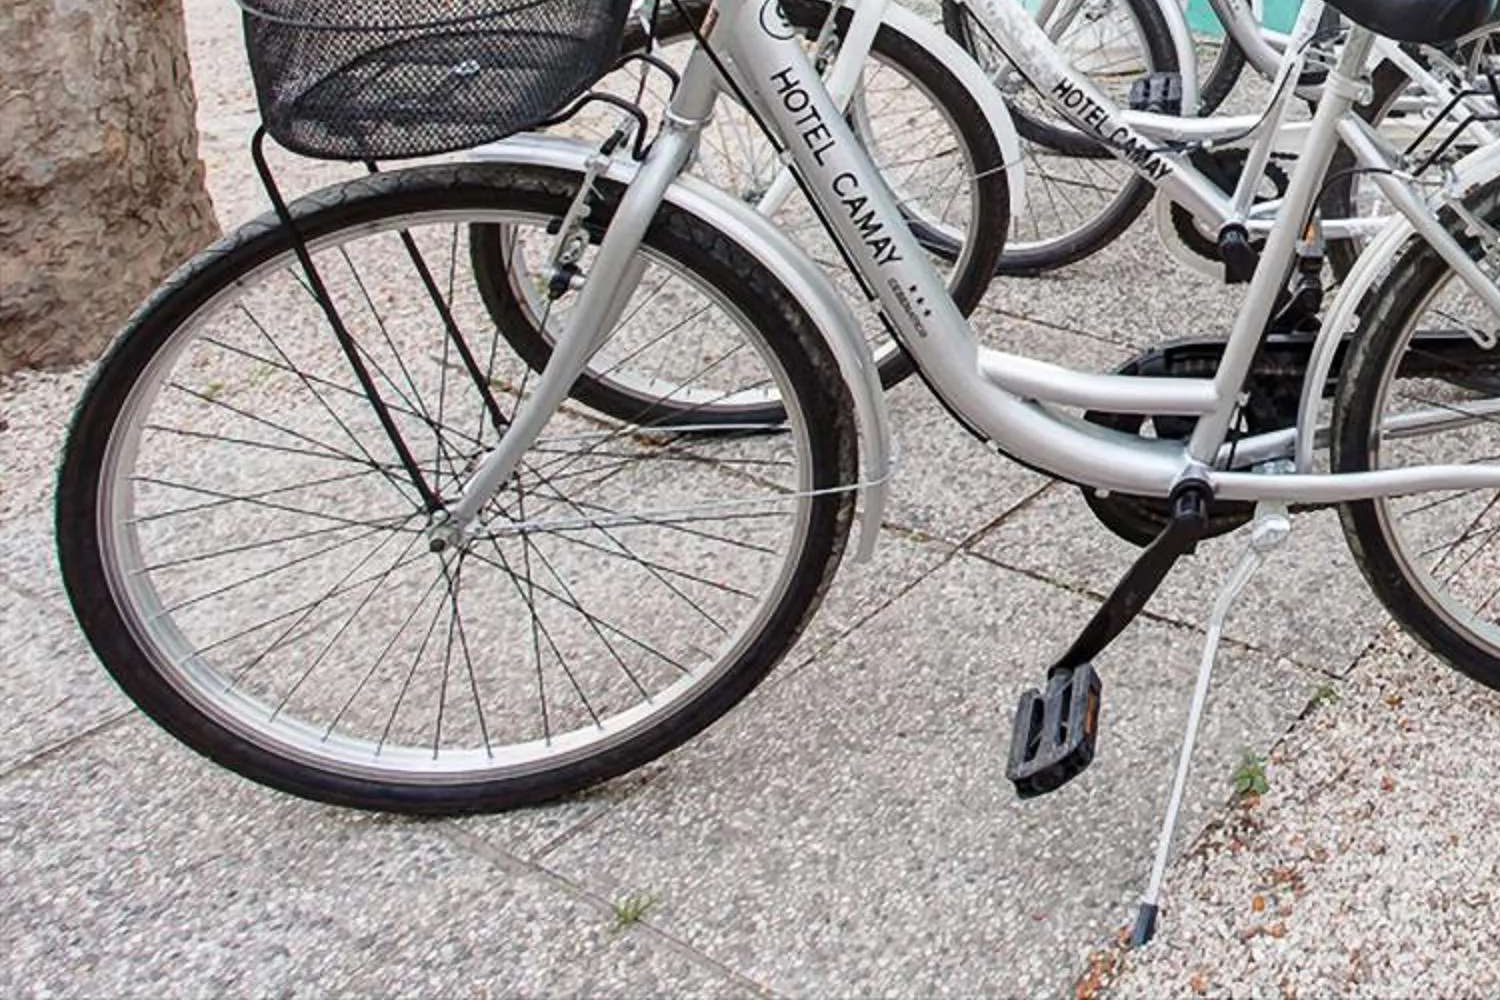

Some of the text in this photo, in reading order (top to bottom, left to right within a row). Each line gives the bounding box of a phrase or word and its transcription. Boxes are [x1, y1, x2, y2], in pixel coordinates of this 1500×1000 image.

[770, 67, 904, 267] HOTEL CAMAY
[1051, 77, 1173, 181] HOTEL CAMAY
